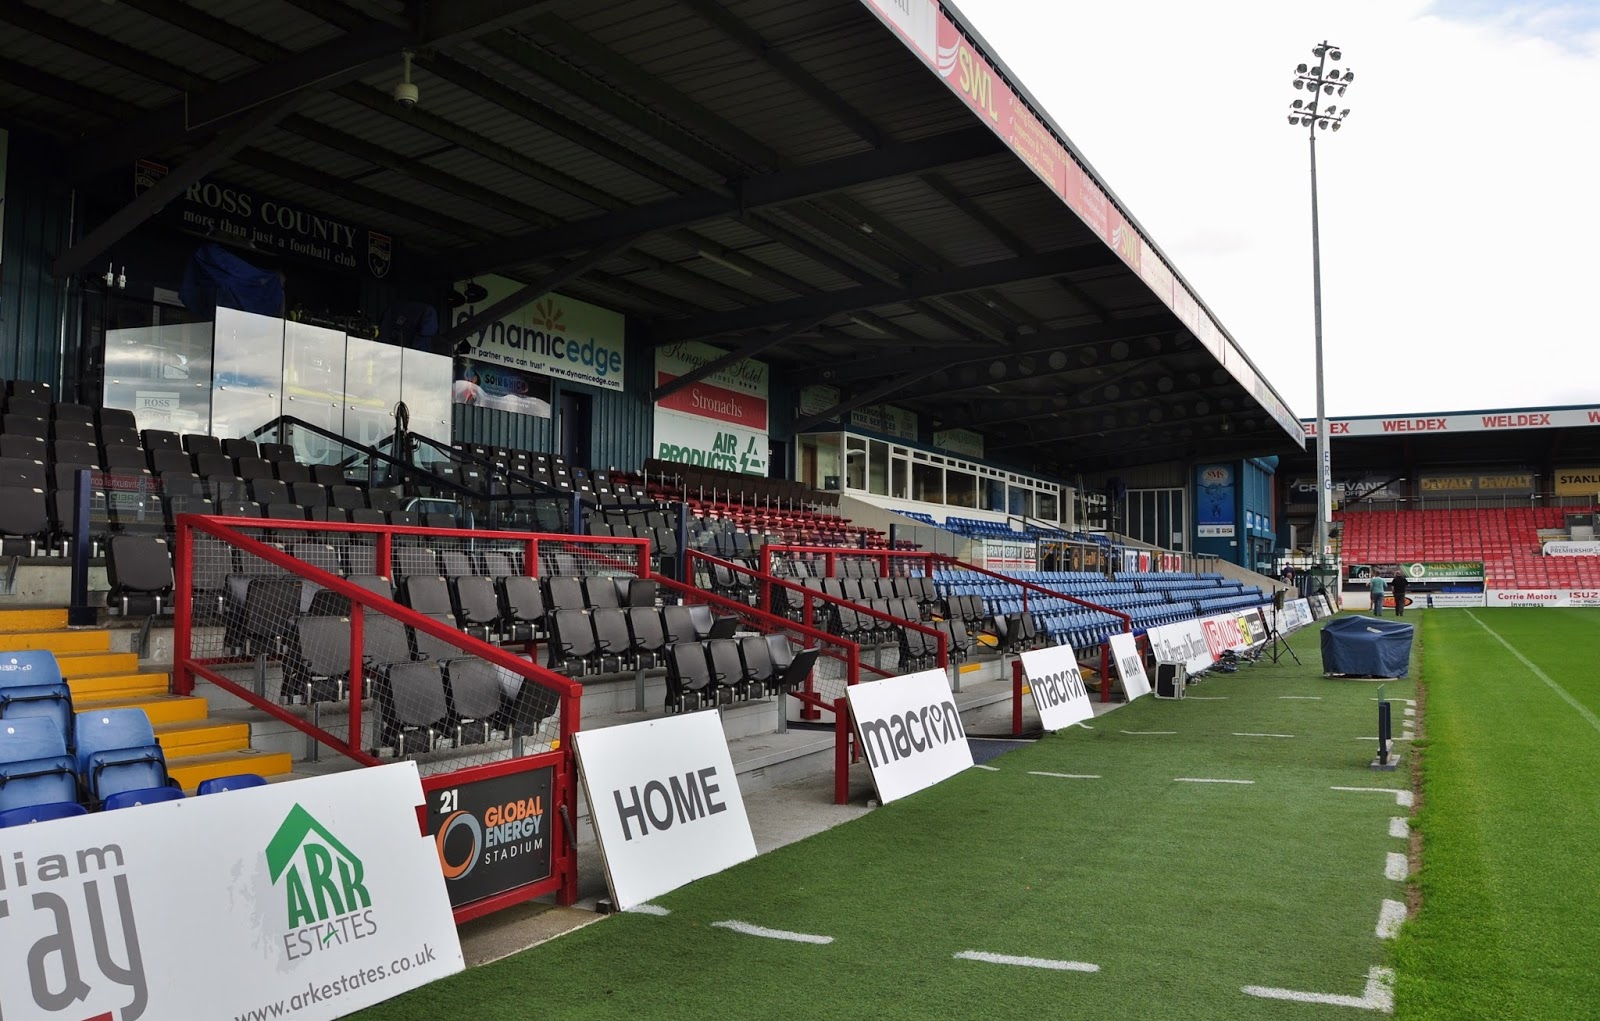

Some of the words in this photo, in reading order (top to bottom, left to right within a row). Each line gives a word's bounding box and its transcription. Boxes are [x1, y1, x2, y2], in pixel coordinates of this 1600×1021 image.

[959, 46, 998, 123] SWL
[185, 180, 253, 218] ROSS
[260, 200, 358, 249] COUNTY
[184, 210, 215, 229] more
[220, 217, 247, 237] than
[250, 226, 273, 245] just
[278, 238, 285, 248] a
[289, 236, 331, 262] football
[334, 250, 357, 268] club
[478, 349, 501, 361] partner
[503, 354, 514, 364] you
[516, 358, 528, 367] can
[729, 359, 763, 384] Hotel
[549, 366, 620, 389] www.dynamicedge.com
[144, 399, 170, 407] ROSS
[692, 388, 743, 418] Stronachs
[1304, 423, 1350, 435] ELEX
[1383, 419, 1447, 431] WELDEX
[1482, 414, 1551, 427] WELDEX
[658, 443, 737, 472] PRODUCTS
[712, 432, 737, 455] AIR
[1299, 481, 1387, 492] CR-EVANS
[1005, 547, 1021, 558] GRAY
[1024, 548, 1036, 558] GRA
[1527, 592, 1557, 600] Motors
[1122, 655, 1141, 678] AWAY
[1030, 668, 1086, 711] macron
[860, 700, 964, 769] macron
[440, 789, 458, 814] 21
[484, 795, 543, 828] GLOBAL
[613, 766, 727, 842] HOME
[485, 814, 542, 848] ENERGY
[485, 838, 543, 864] STADIUM
[286, 843, 372, 930] ARK
[0, 874, 149, 1021] ay
[283, 910, 378, 961] ESTATES
[234, 943, 437, 1021] www.arkestates.co.uk
